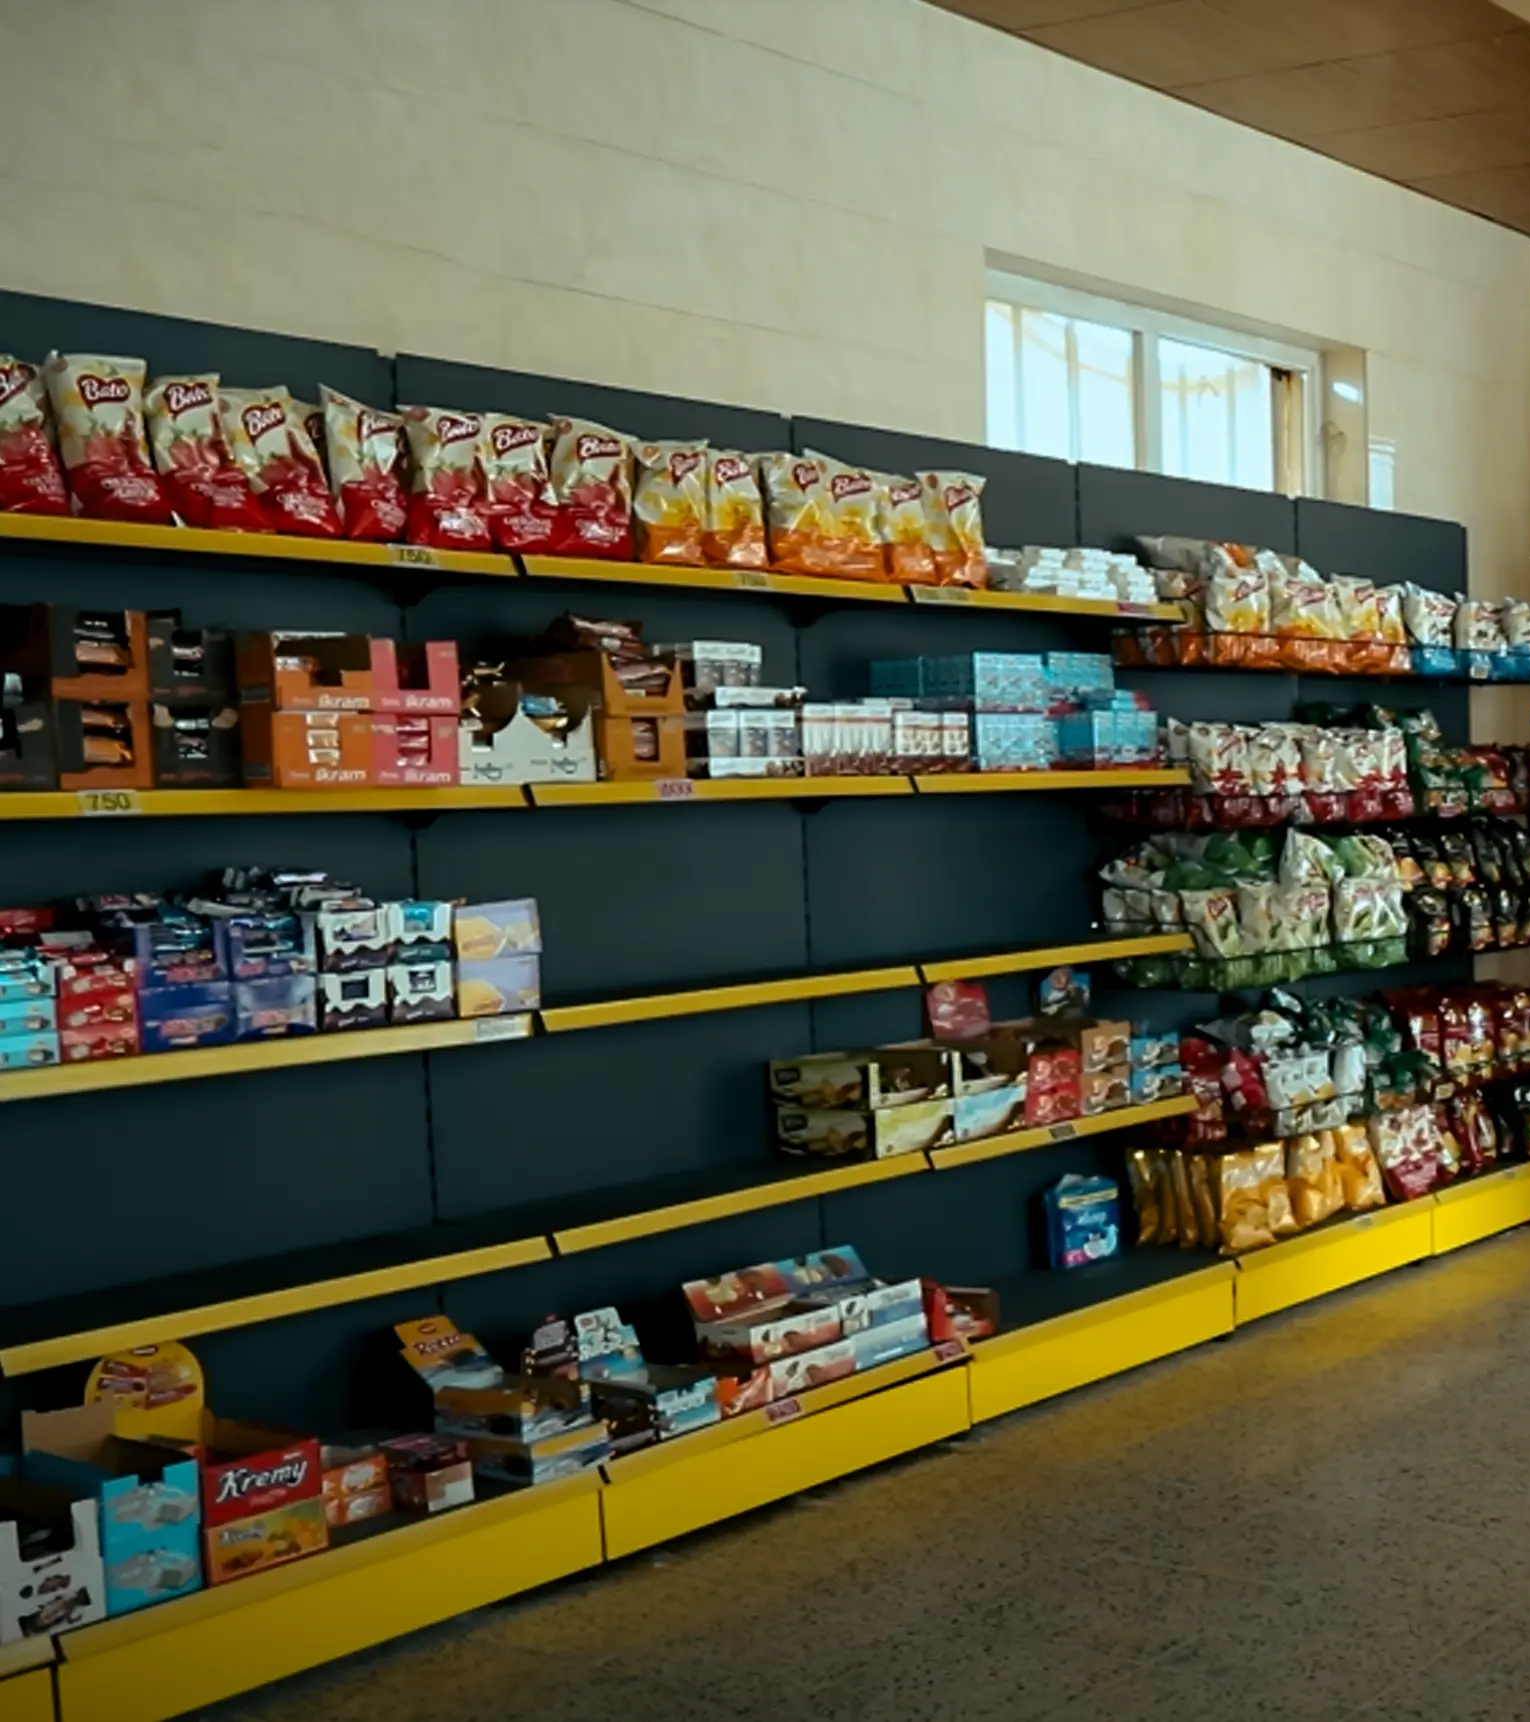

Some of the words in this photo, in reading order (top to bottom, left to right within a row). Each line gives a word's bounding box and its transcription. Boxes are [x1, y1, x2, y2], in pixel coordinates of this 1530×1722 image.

[81, 379, 130, 400] Bato
[494, 429, 539, 450] Bato
[318, 693, 371, 709] ikram
[405, 694, 453, 709] ikram
[315, 767, 367, 783] ikram
[404, 768, 452, 783] ikram
[85, 794, 132, 812] 750
[215, 1460, 308, 1503] Kremy
